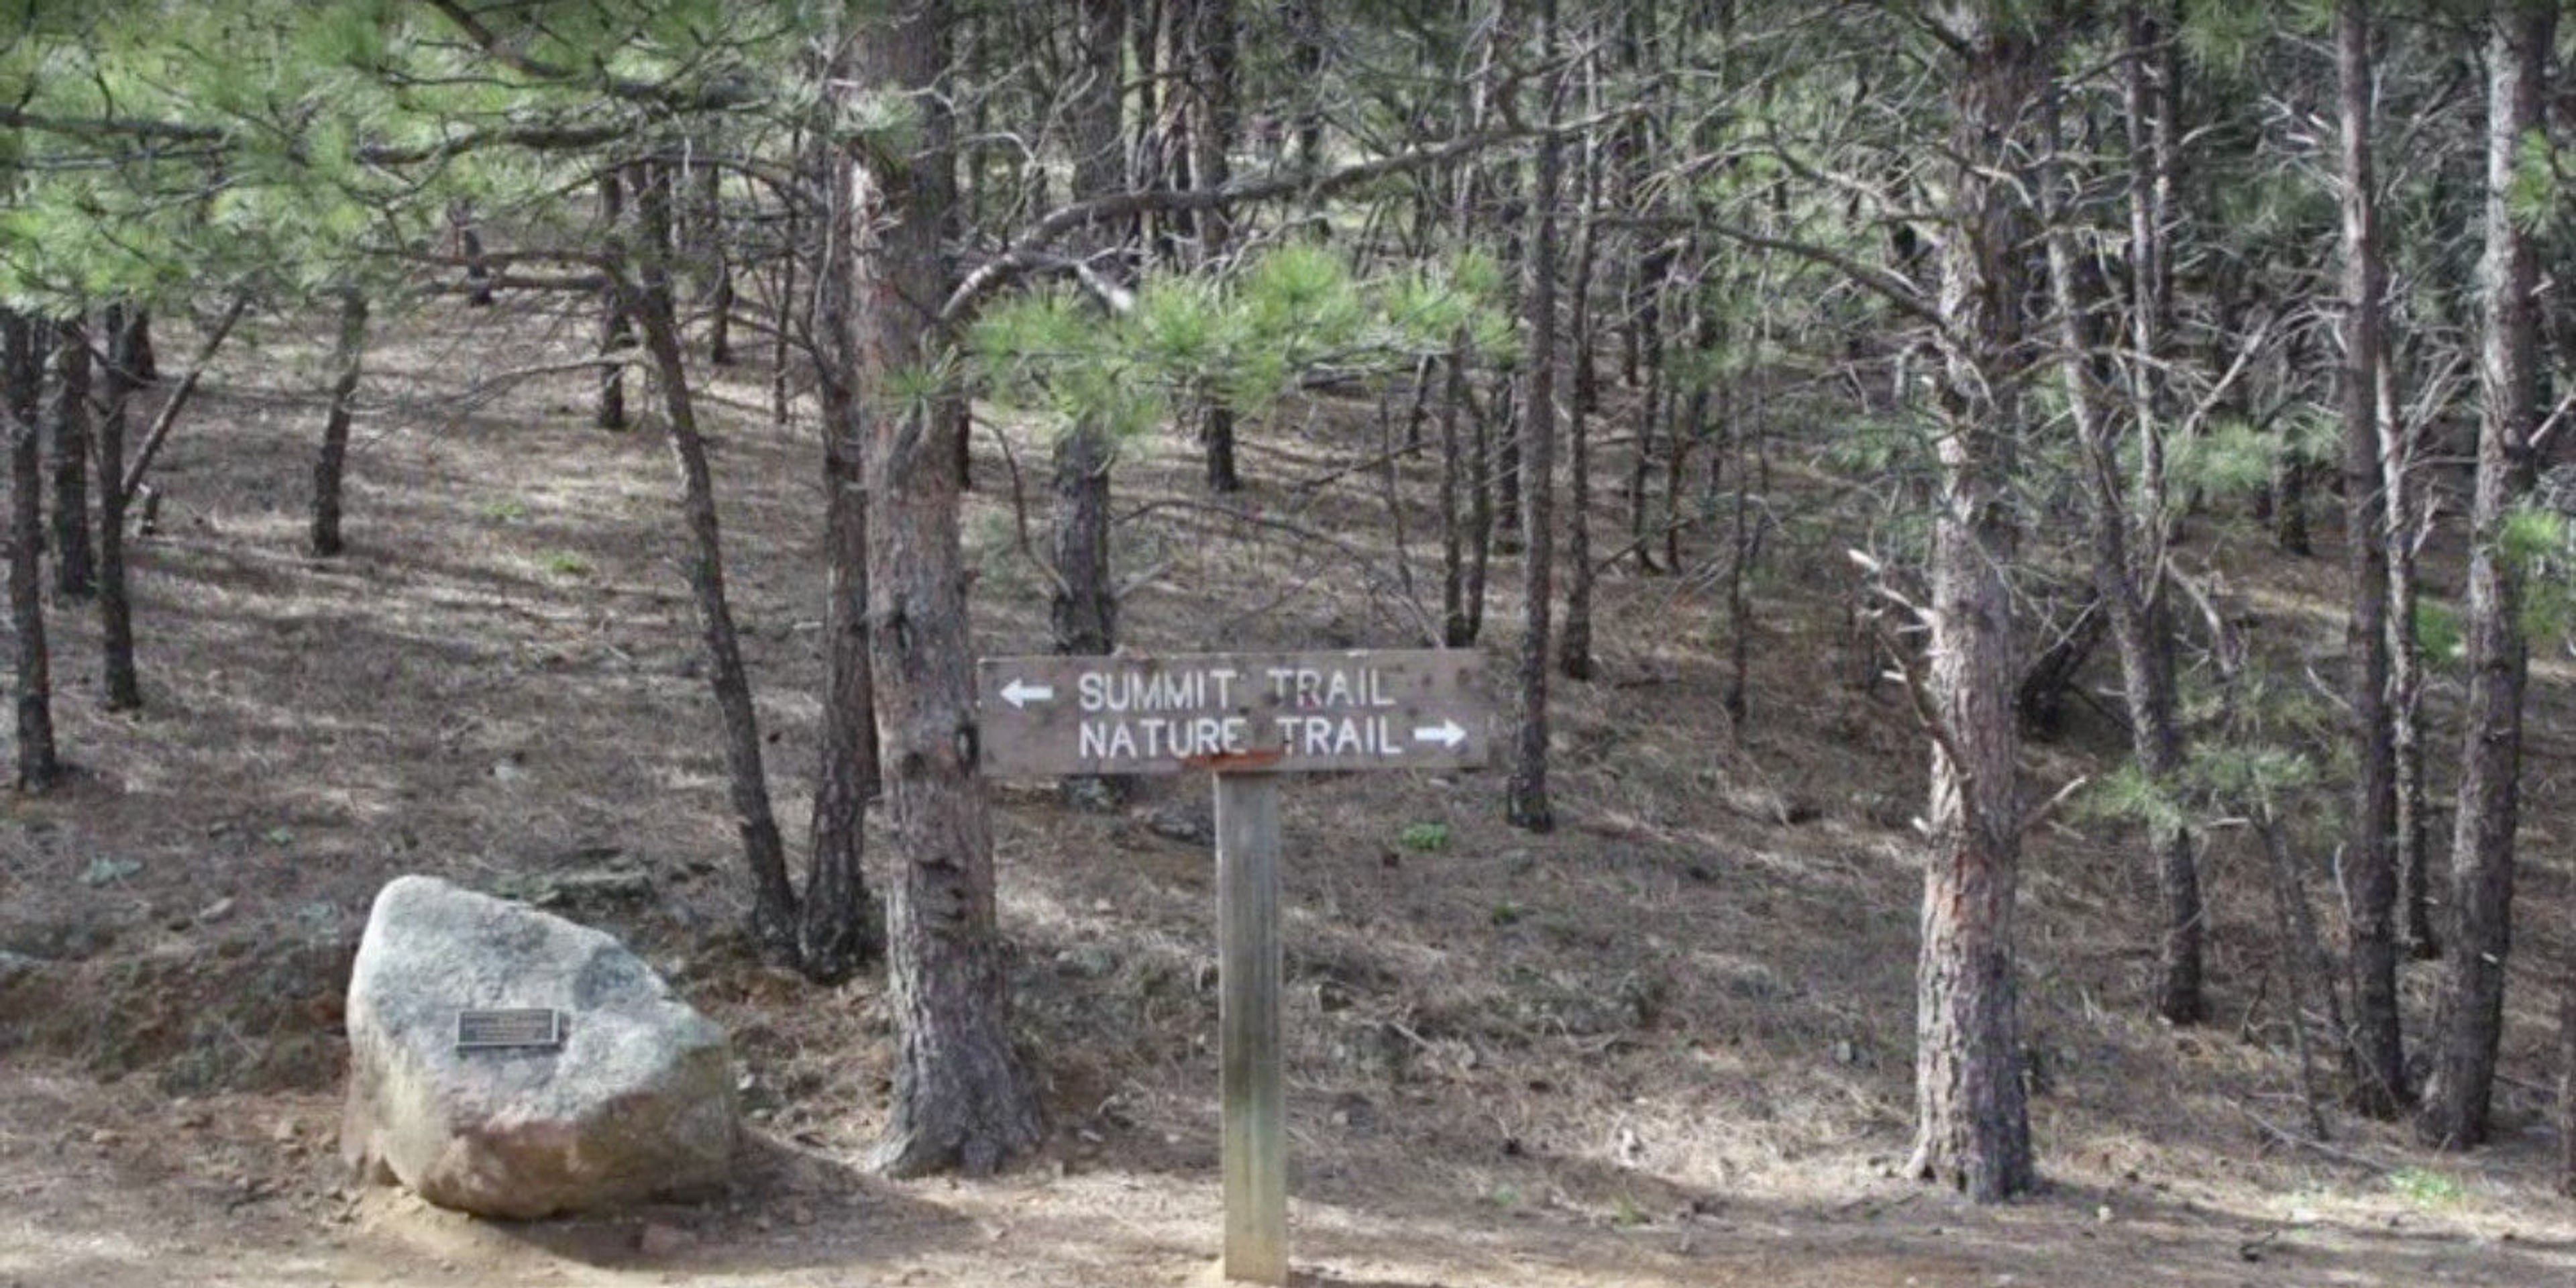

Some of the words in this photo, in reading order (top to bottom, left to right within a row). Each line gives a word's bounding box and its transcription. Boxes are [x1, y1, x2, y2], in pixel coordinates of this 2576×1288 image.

[1078, 669, 1238, 710] SUMMIT
[1267, 669, 1396, 708] TRAIL
[1079, 717, 1247, 758] NATURE
[1275, 716, 1403, 755] TRAIL
